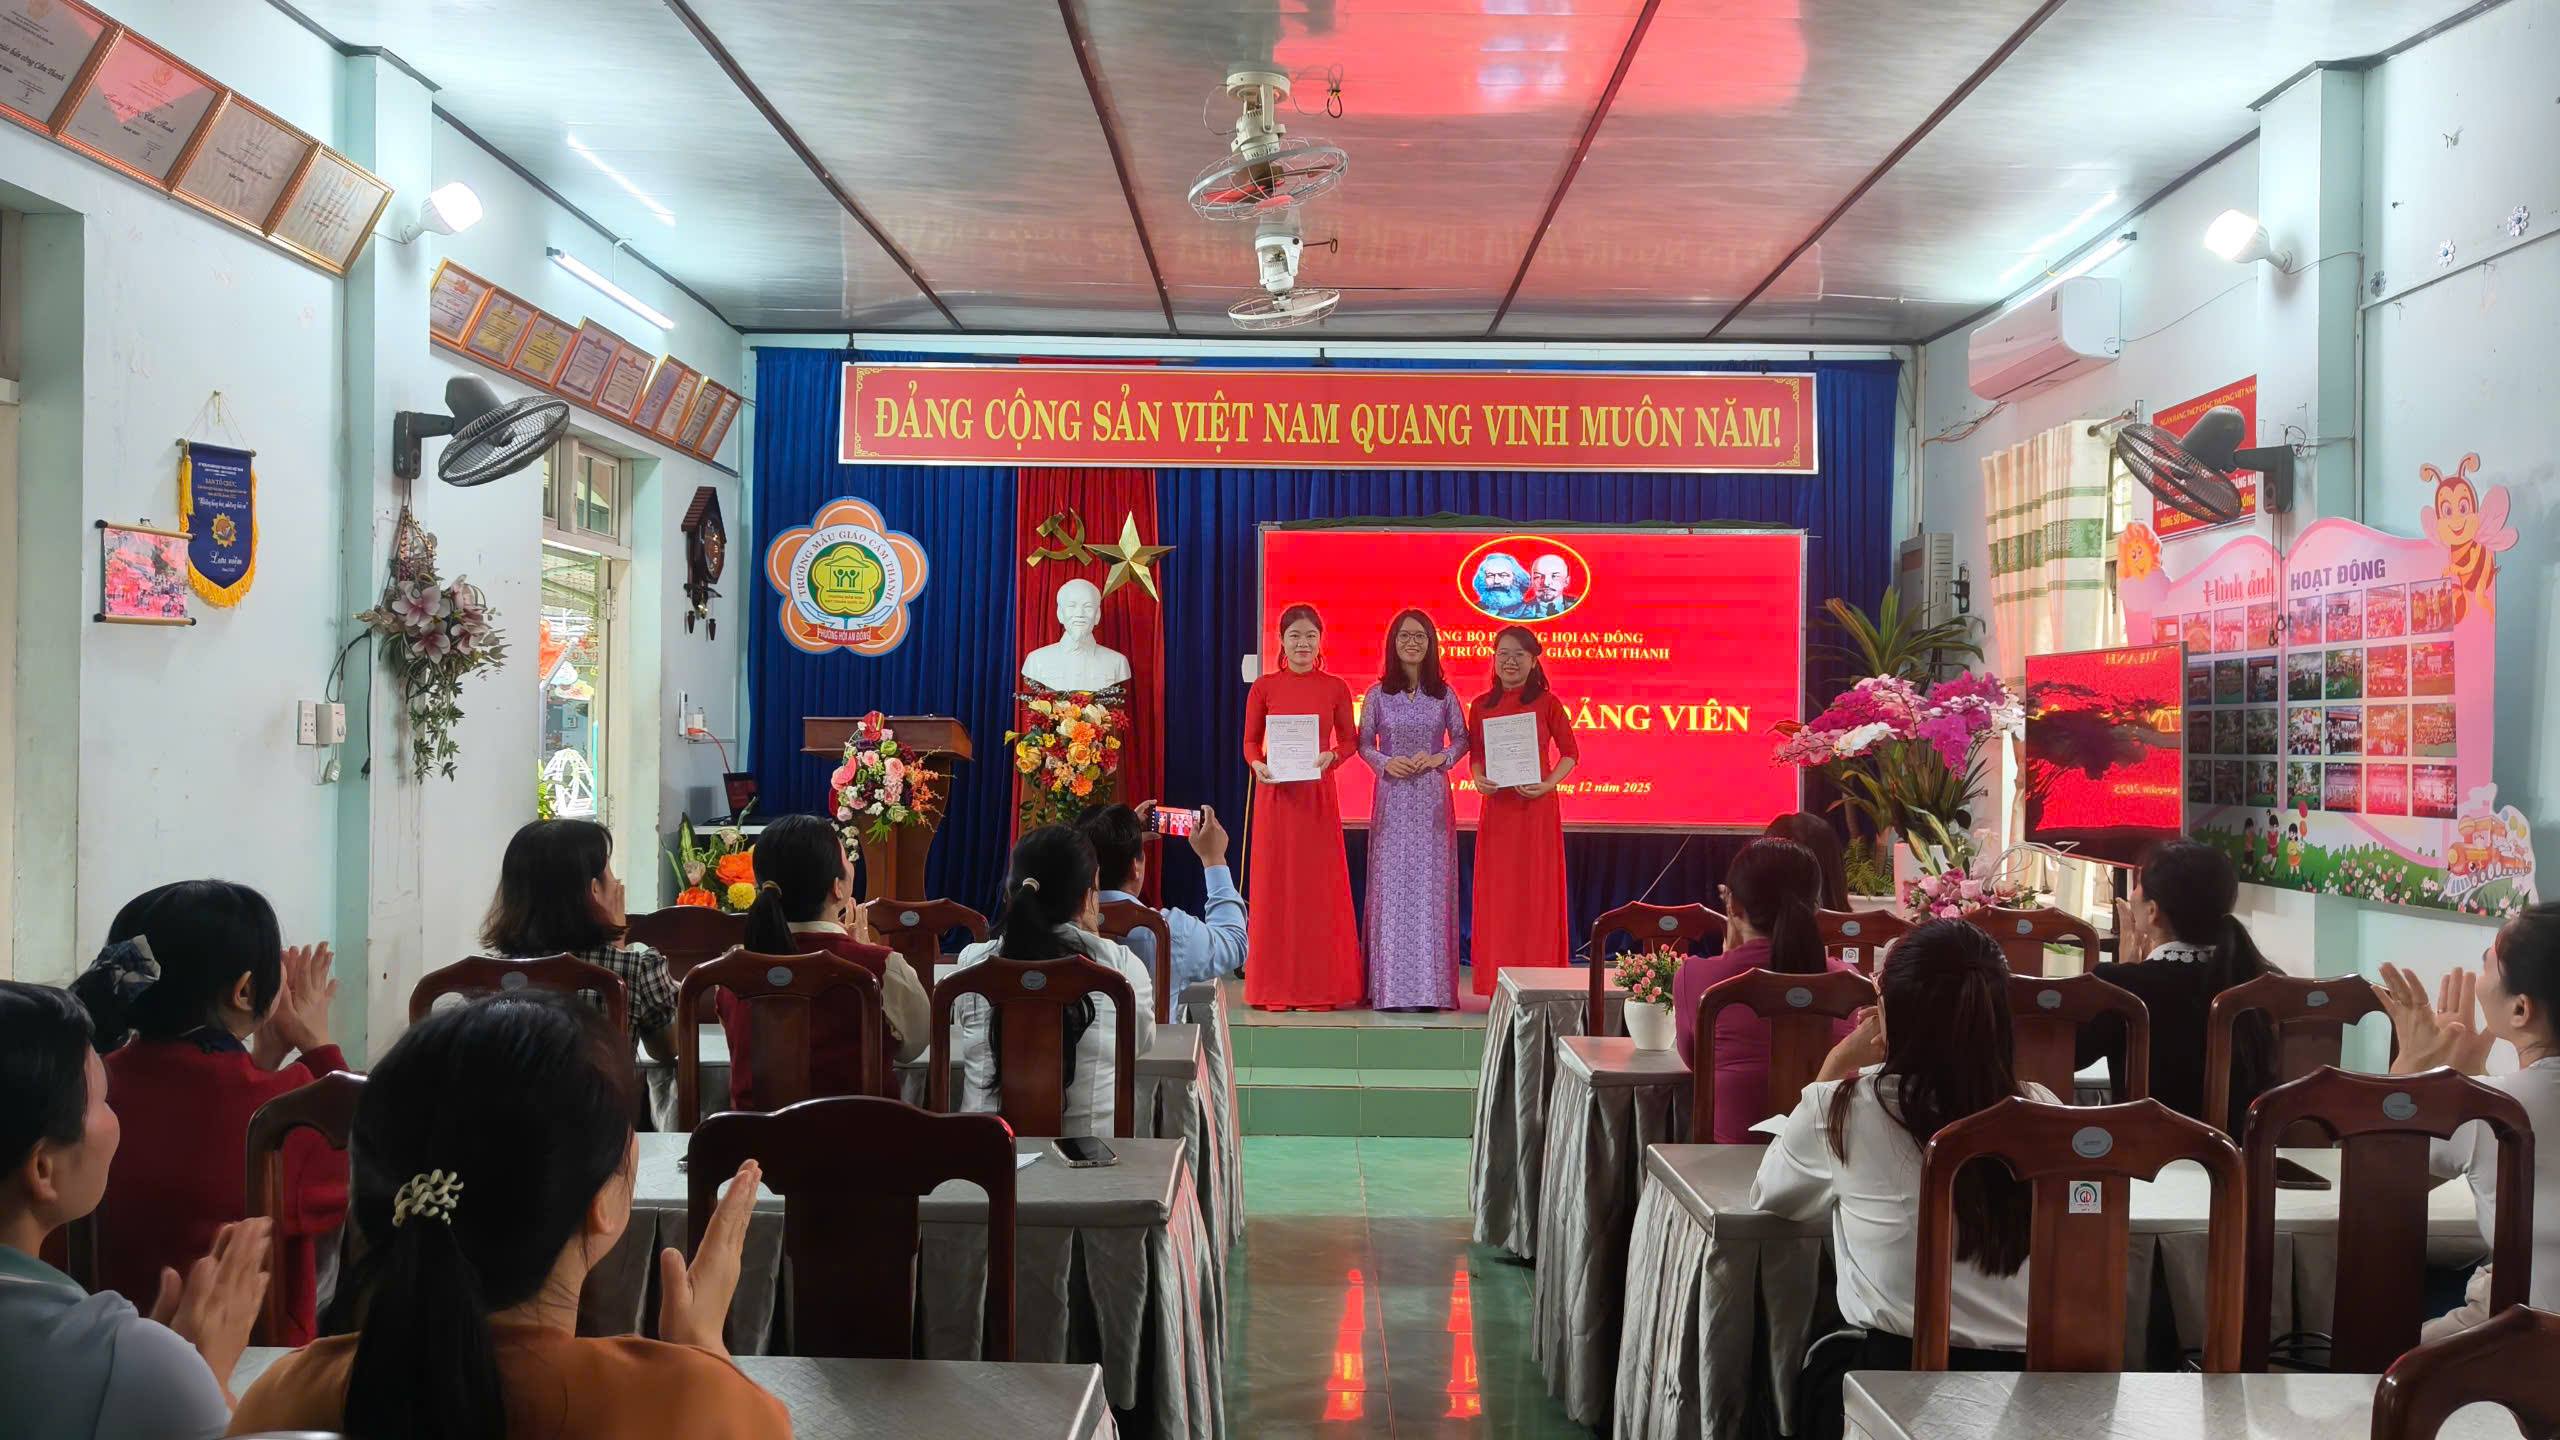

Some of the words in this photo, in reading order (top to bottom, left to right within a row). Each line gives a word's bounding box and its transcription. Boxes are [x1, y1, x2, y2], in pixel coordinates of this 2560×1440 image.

[874, 381, 973, 440] ĐẢNG
[984, 387, 1082, 450] CỘNG
[1093, 383, 1162, 442] SẢN
[1171, 389, 1254, 453] VIỆT
[1263, 402, 1341, 444] NAM
[1351, 403, 1472, 454] QUANG
[1483, 405, 1570, 446] VINH
[1579, 394, 1685, 447] MUÔN
[1694, 398, 1781, 449] NĂM!
[886, 560, 897, 601] THANH
[2290, 567, 2332, 592] HOẠT
[2336, 558, 2386, 587] ĐỘNG
[1435, 628, 1462, 642] ẢNG
[1466, 629, 1486, 645] BỘ
[1551, 631, 1578, 647] HỘI
[1581, 631, 1599, 644] AN
[1603, 629, 1644, 644] ĐÔNG
[1447, 643, 1495, 657] TRƯỜN
[1620, 647, 1670, 659] THANH
[1660, 697, 1751, 733] VIÊN
[1578, 781, 1593, 793] 12
[1594, 782, 1620, 793] năm
[1622, 781, 1652, 793] 2025
